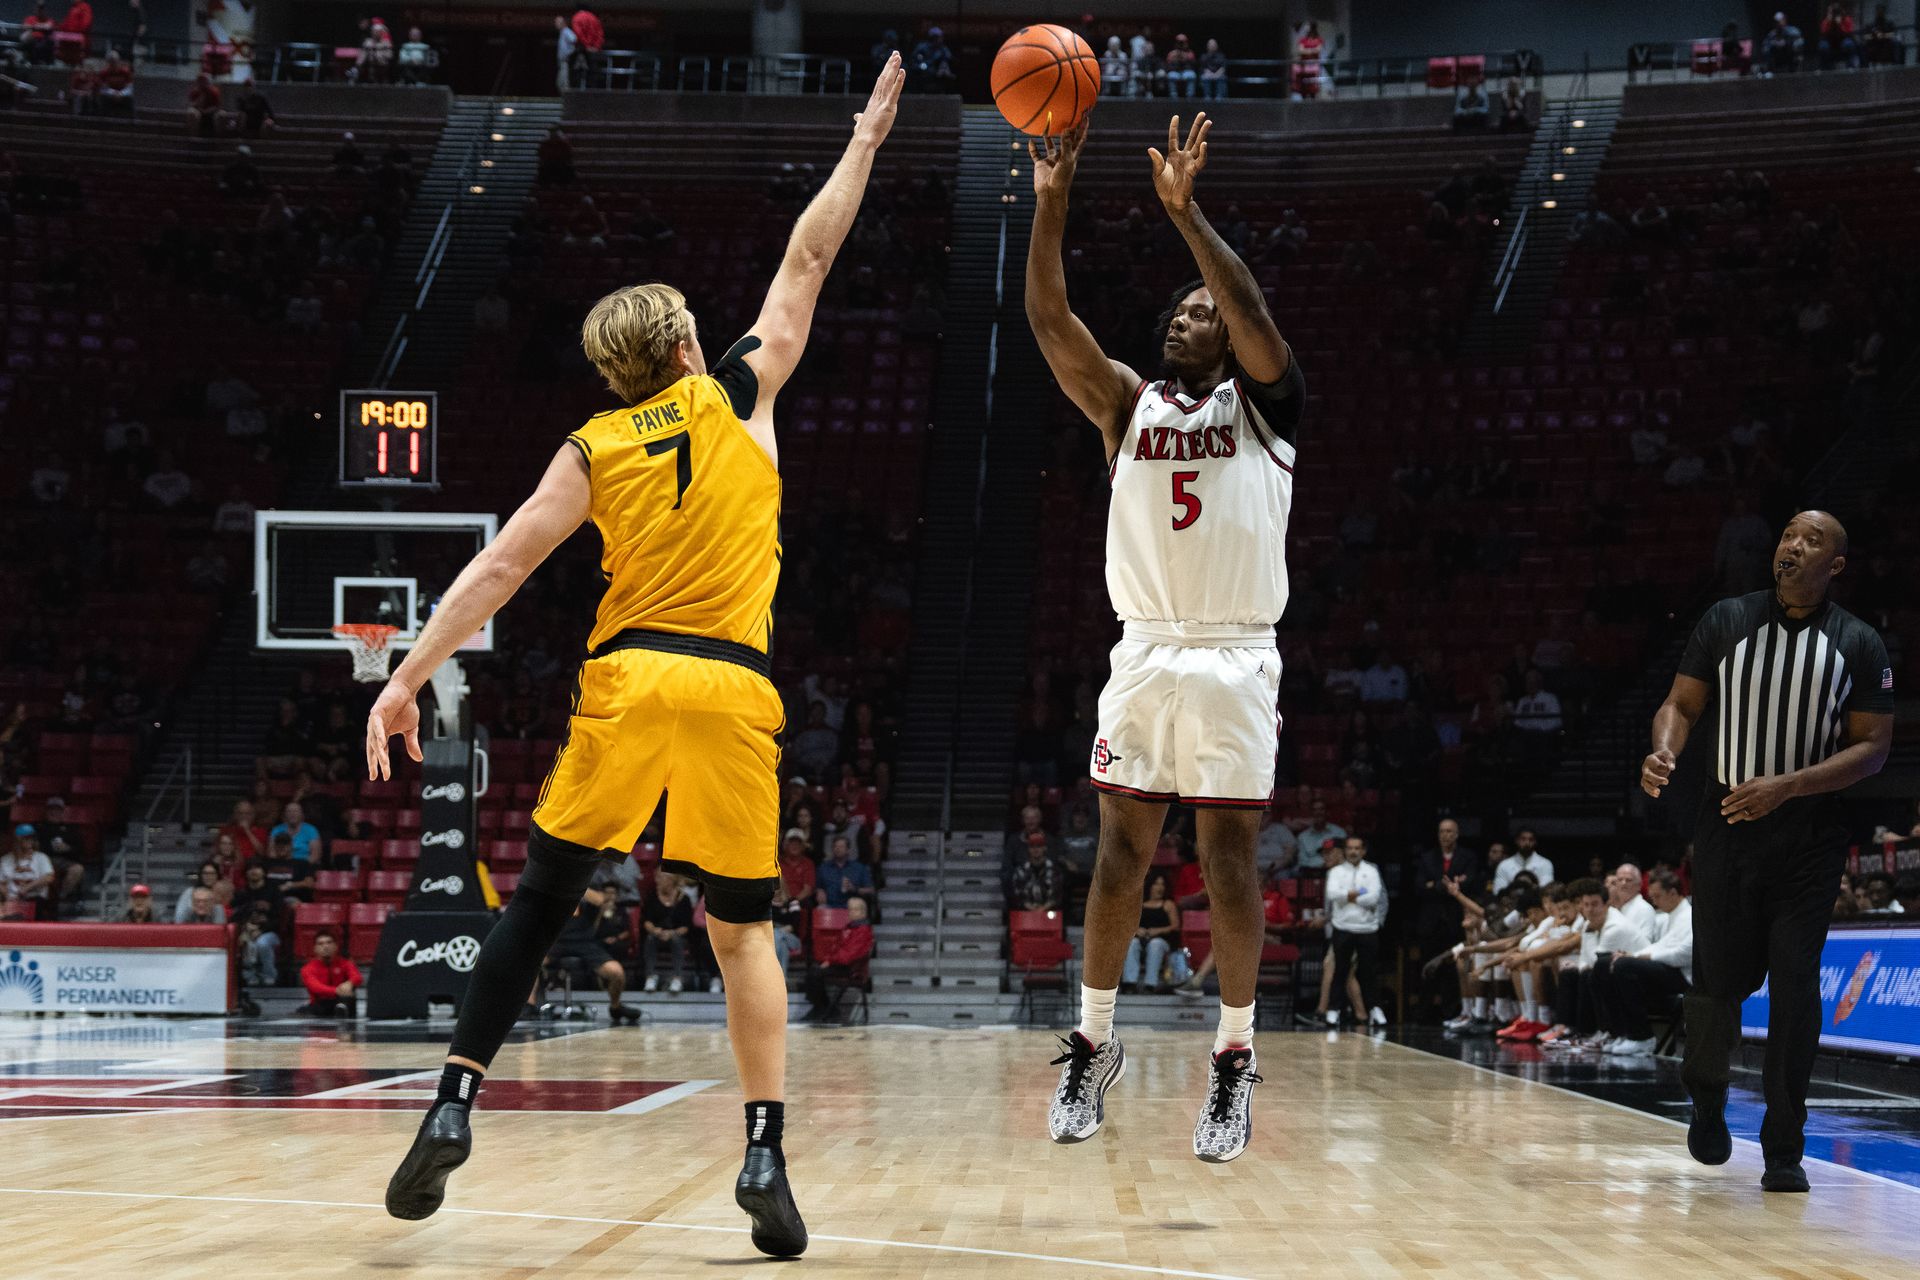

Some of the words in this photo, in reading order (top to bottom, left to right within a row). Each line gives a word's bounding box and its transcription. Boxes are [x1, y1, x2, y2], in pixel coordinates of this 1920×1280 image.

[361, 401, 427, 429] 19:00
[631, 401, 685, 435] PAYNE
[1133, 424, 1237, 461] AZTECS
[643, 429, 692, 510] 7
[1171, 471, 1203, 531] 5
[57, 967, 116, 982] KAISER
[57, 989, 177, 1005] PERMANENTE
